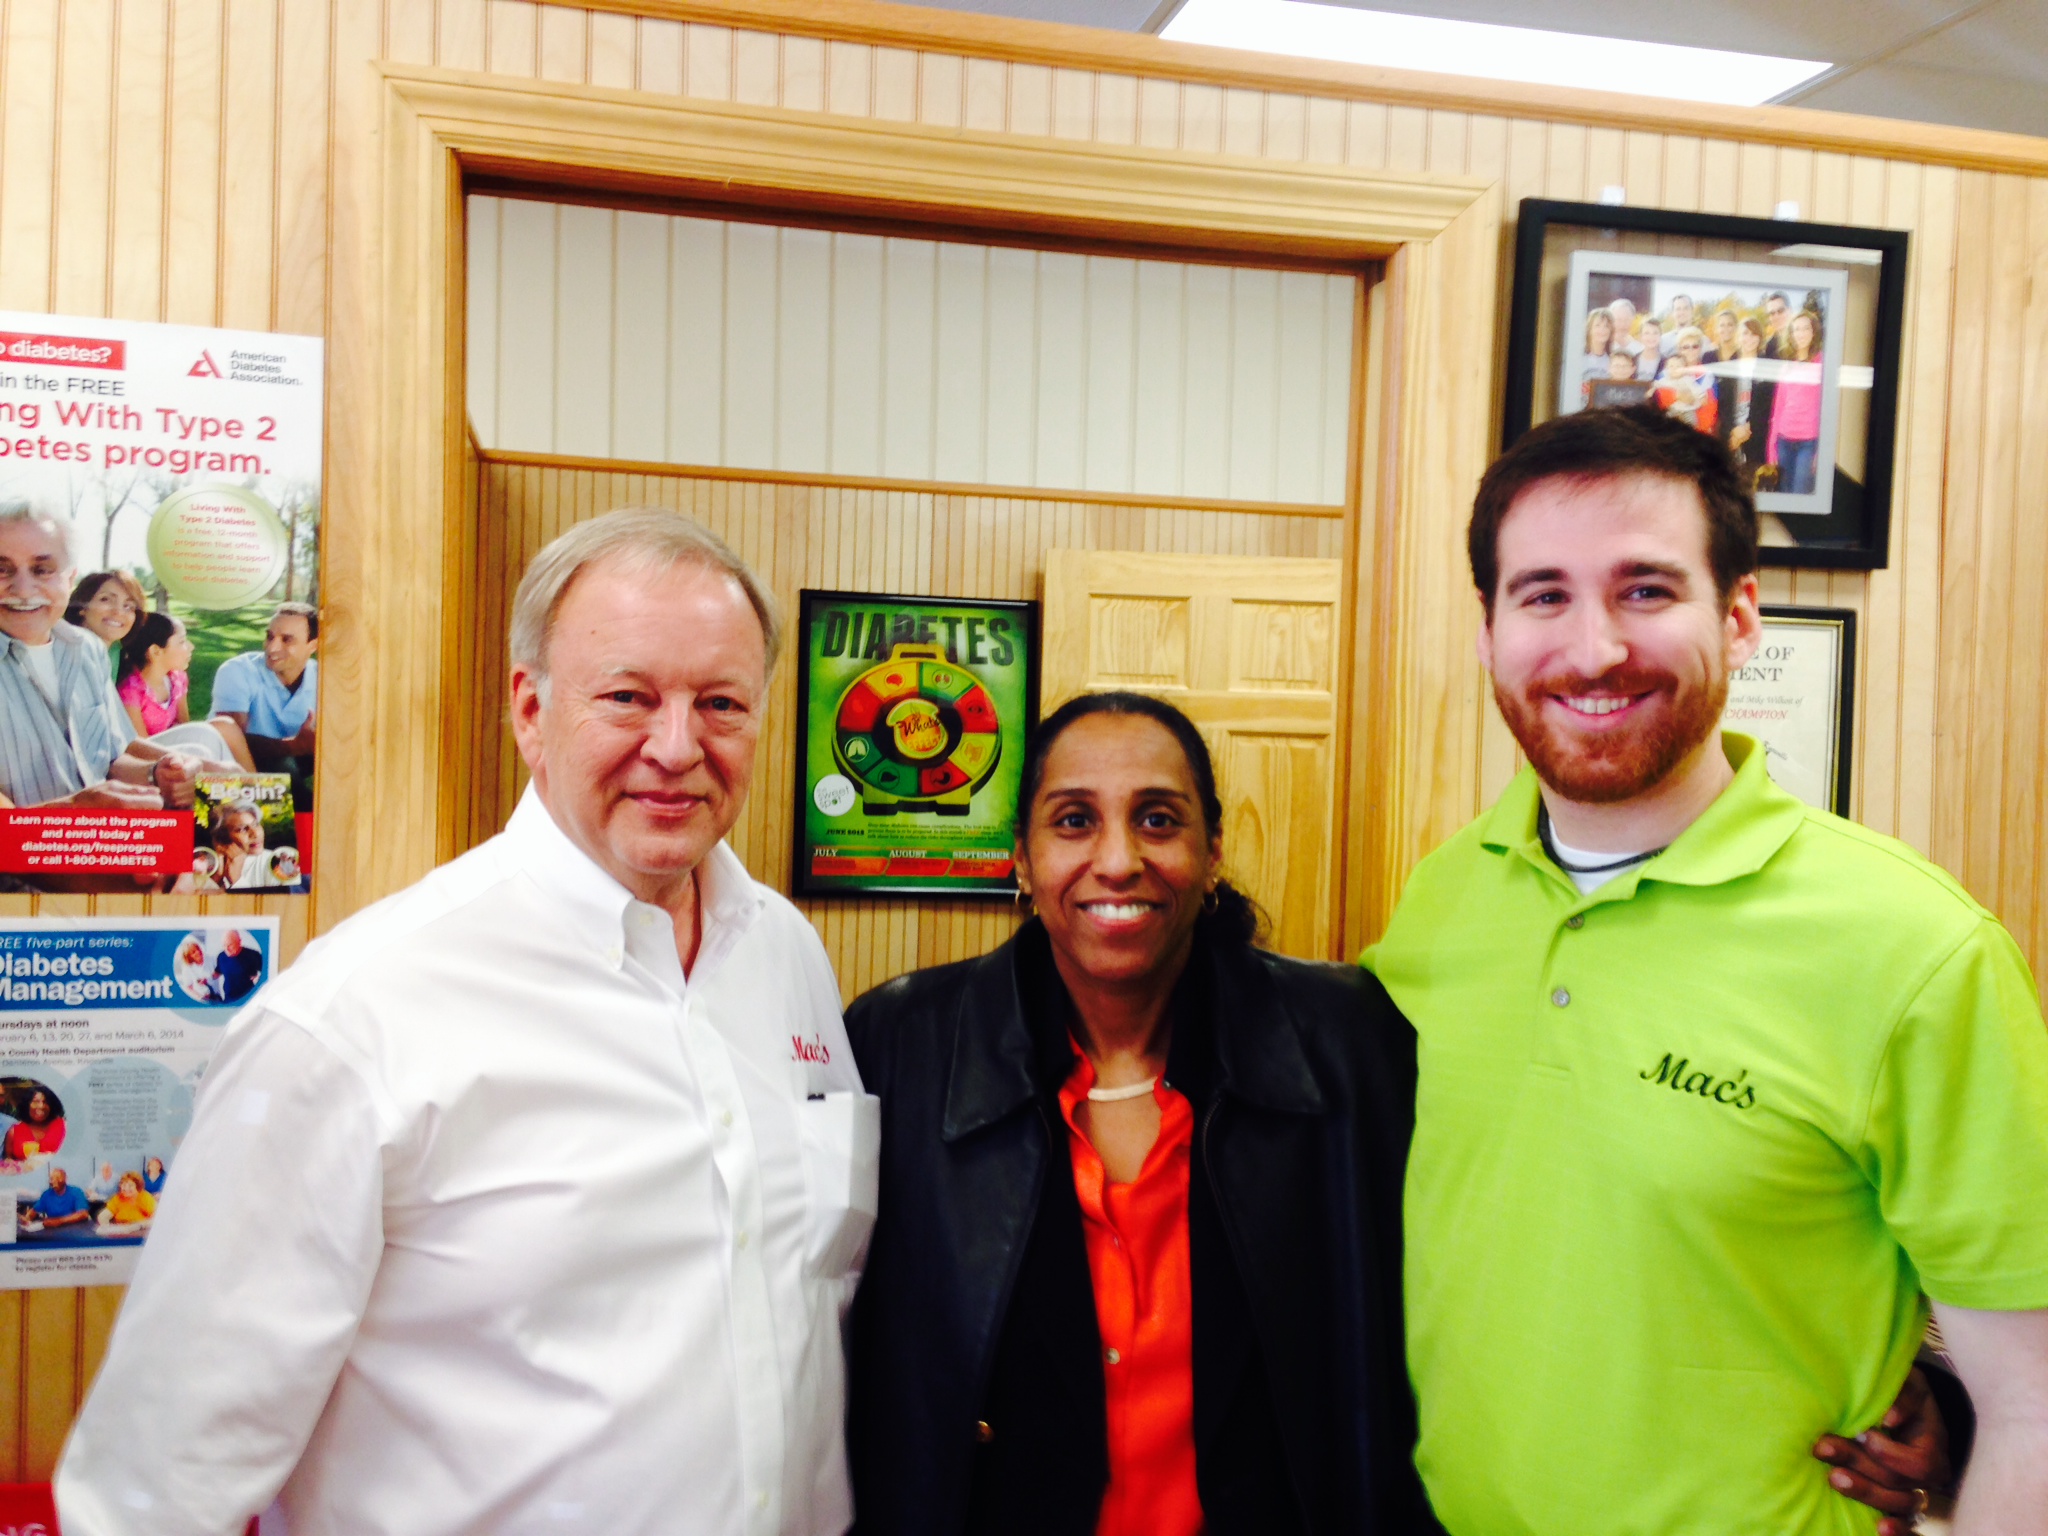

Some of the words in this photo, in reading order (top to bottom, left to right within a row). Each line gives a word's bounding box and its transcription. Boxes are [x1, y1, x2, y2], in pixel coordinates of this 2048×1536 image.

[8, 339, 112, 364] diabetes?
[231, 349, 287, 363] American
[231, 360, 282, 374] Diabetes
[24, 374, 59, 392] the
[67, 377, 125, 397] FREE
[55, 400, 142, 430] With
[156, 407, 244, 441] Type
[257, 415, 277, 441] 2
[105, 442, 271, 475] program.
[191, 503, 220, 513] Living
[180, 514, 203, 524] Type
[215, 517, 256, 526] Diabetes
[822, 611, 1015, 666] DIABETES
[1765, 646, 1795, 660] OF
[1725, 709, 1788, 720] CHAMPION
[210, 783, 287, 802] Begin?
[9, 815, 41, 825] Learn
[43, 816, 72, 825] more
[74, 815, 107, 826] about
[110, 816, 128, 826] the
[130, 817, 177, 829] program
[42, 829, 63, 839] and
[65, 829, 97, 839] enroll
[99, 829, 131, 841] today
[133, 830, 145, 840] at
[21, 841, 164, 854] diabetes.org/freeprogram
[814, 848, 838, 857] JULY
[889, 849, 928, 858] AUGUST
[952, 850, 1009, 860] SEPTEMBER
[28, 856, 40, 865] or
[42, 854, 62, 865] call
[65, 855, 157, 866] 1-800-DIABETES
[89, 935, 134, 949] series:
[0, 952, 114, 977] iabetes
[46, 1020, 57, 1028] at
[61, 1020, 90, 1029] noon
[94, 1031, 113, 1040] and
[115, 1031, 145, 1040] March
[160, 1029, 184, 1039] 2014
[8, 1048, 40, 1057] County
[42, 1047, 71, 1055] Health
[74, 1046, 125, 1055] Department
[128, 1045, 175, 1054] auditorium
[791, 1033, 830, 1065] Mac's
[1640, 1052, 1756, 1109] Mac's
